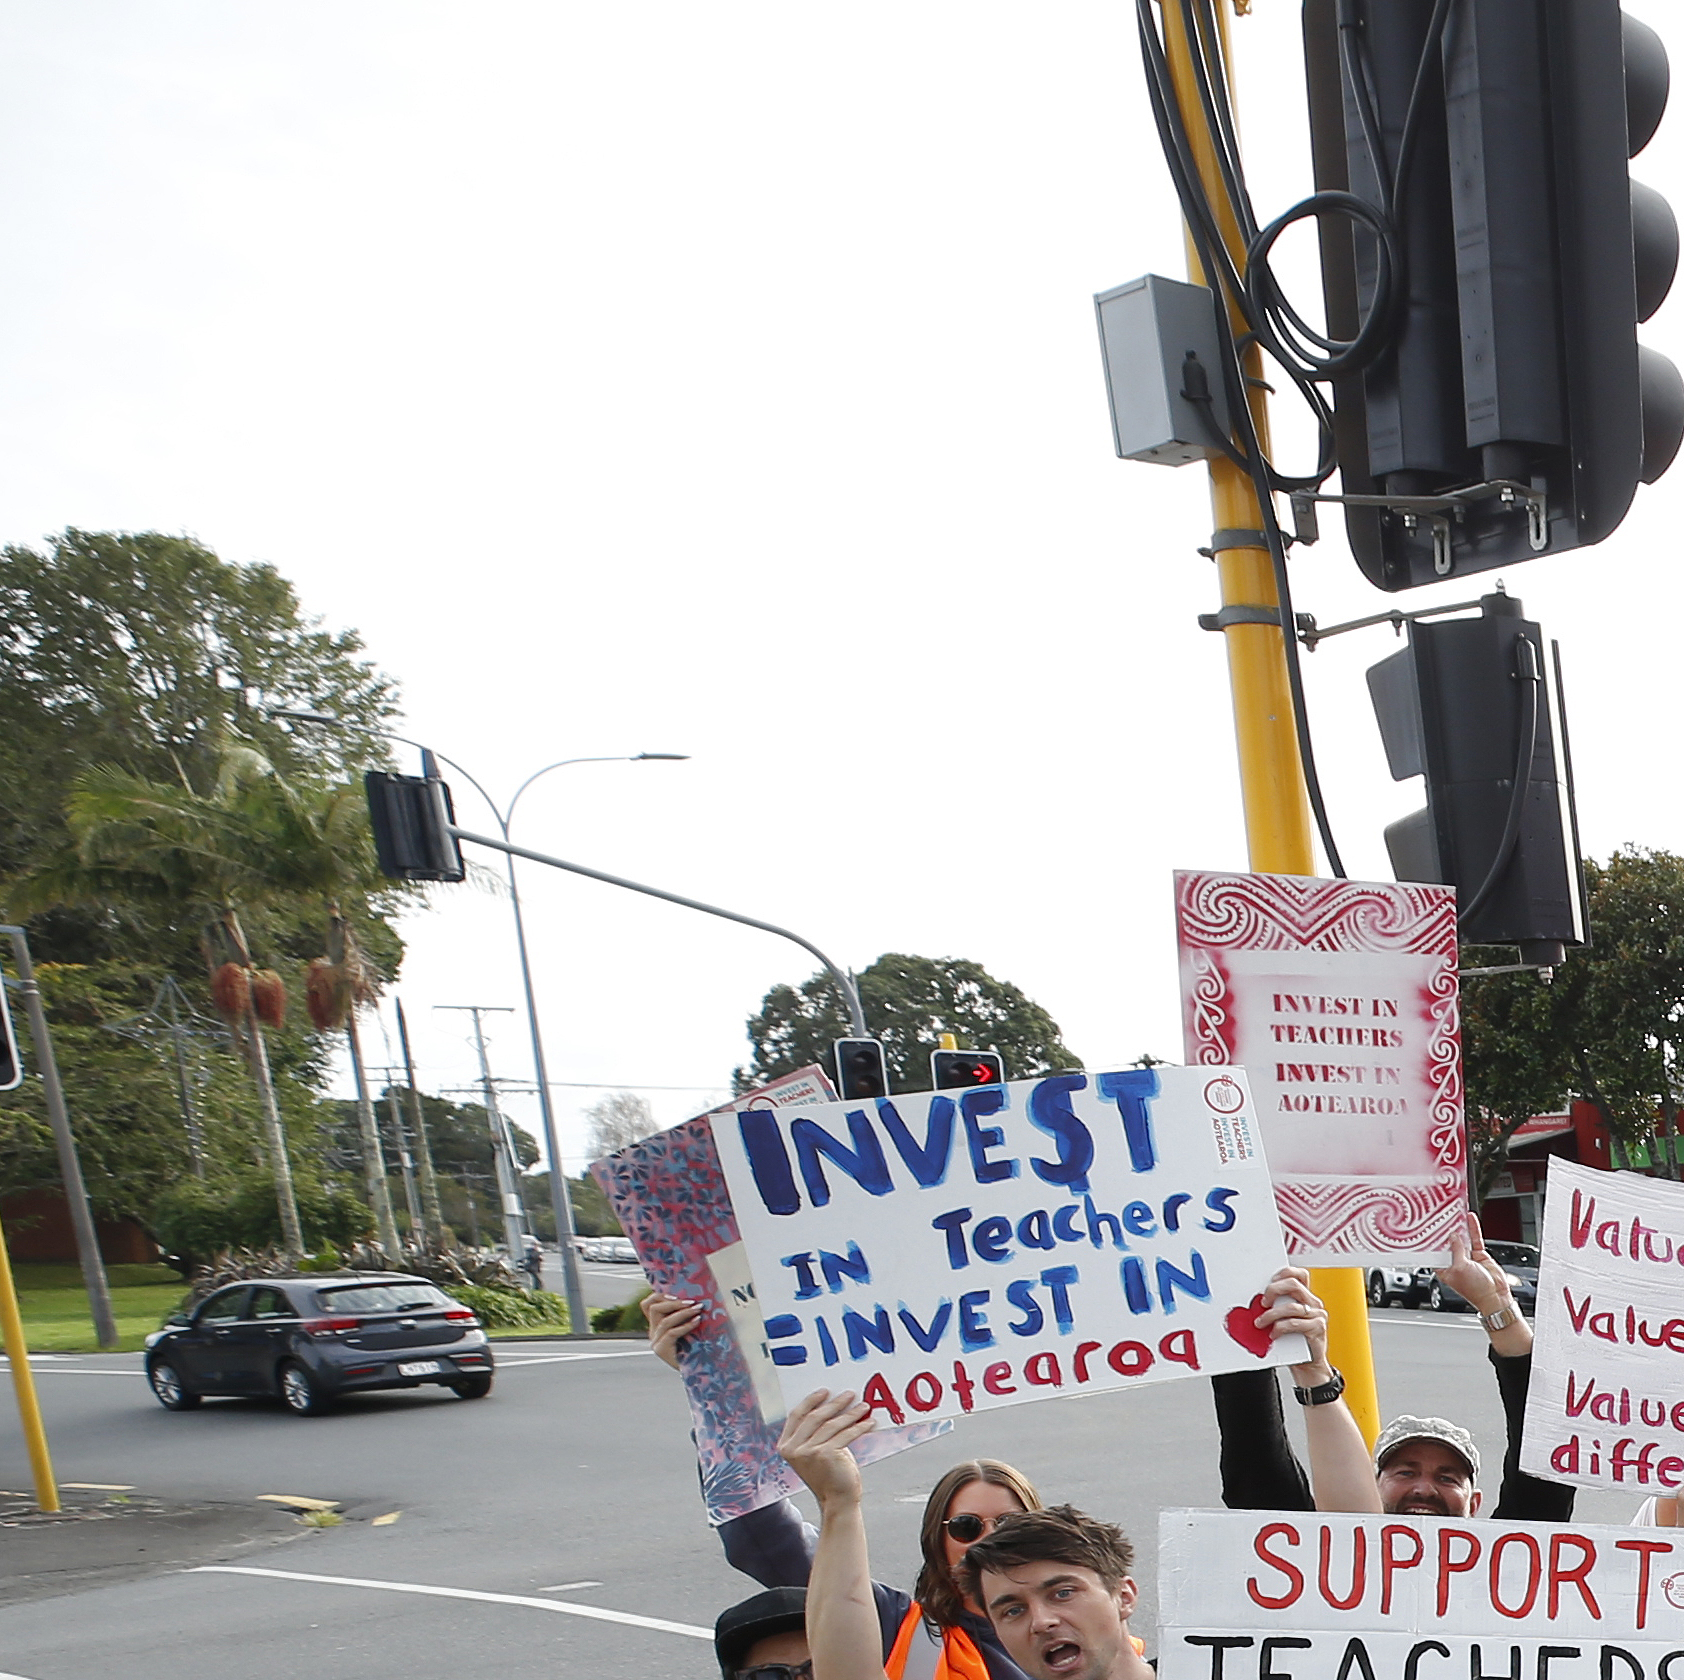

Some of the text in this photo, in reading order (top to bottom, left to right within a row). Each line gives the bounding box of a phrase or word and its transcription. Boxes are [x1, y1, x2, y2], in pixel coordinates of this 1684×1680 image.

[1270, 1024, 1403, 1047] TEACHERS
[1272, 994, 1398, 1017] INVEST IN
[1276, 1063, 1400, 1084] INVEST IN
[1278, 1094, 1409, 1115] AOTEAROA
[737, 1069, 1159, 1217] INVEST
[783, 1187, 1240, 1302] IN Teachers
[1119, 1250, 1215, 1318] IN
[857, 1330, 1201, 1426] Aotearoa
[1247, 1522, 1672, 1629] SUPPORT
